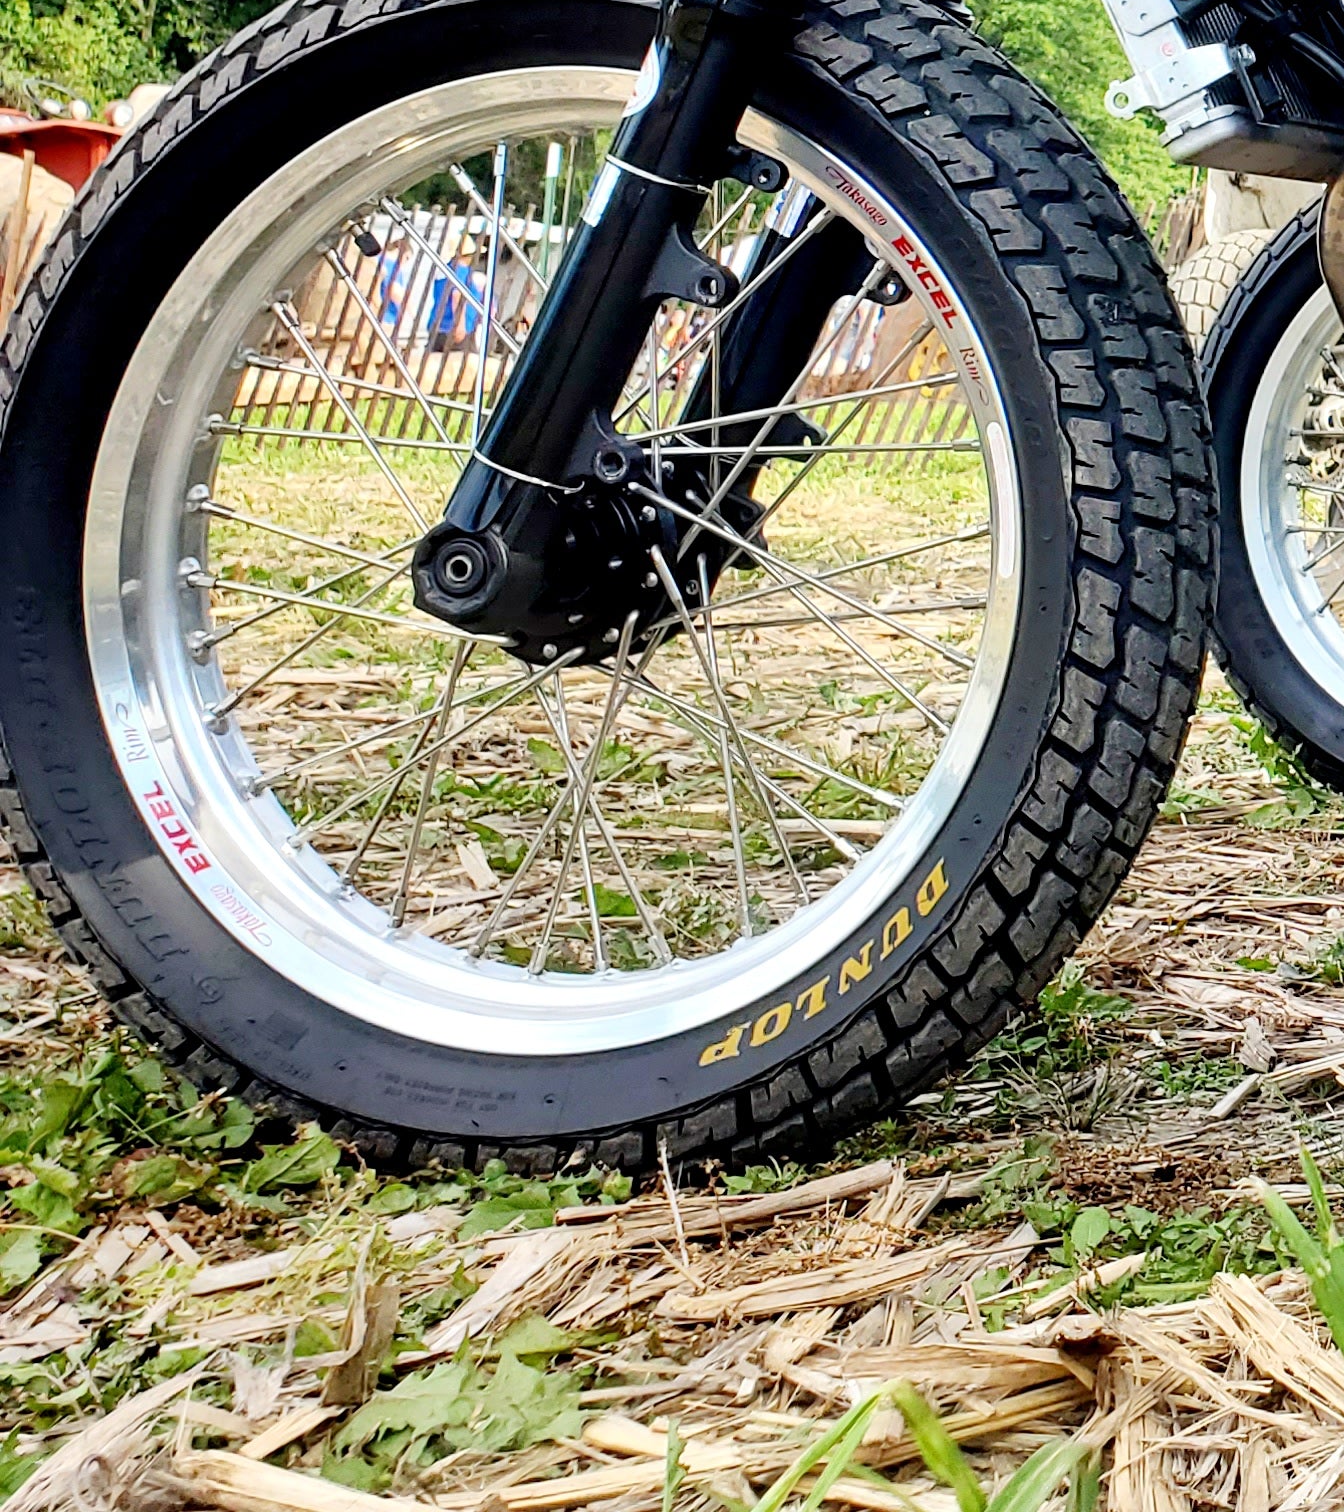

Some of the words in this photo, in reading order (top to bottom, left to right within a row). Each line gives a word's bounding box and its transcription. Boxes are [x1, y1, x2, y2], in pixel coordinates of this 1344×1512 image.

[891, 234, 957, 329] EXCEL
[144, 780, 211, 875] EXCEL
[699, 857, 951, 1068] DUNLOP
